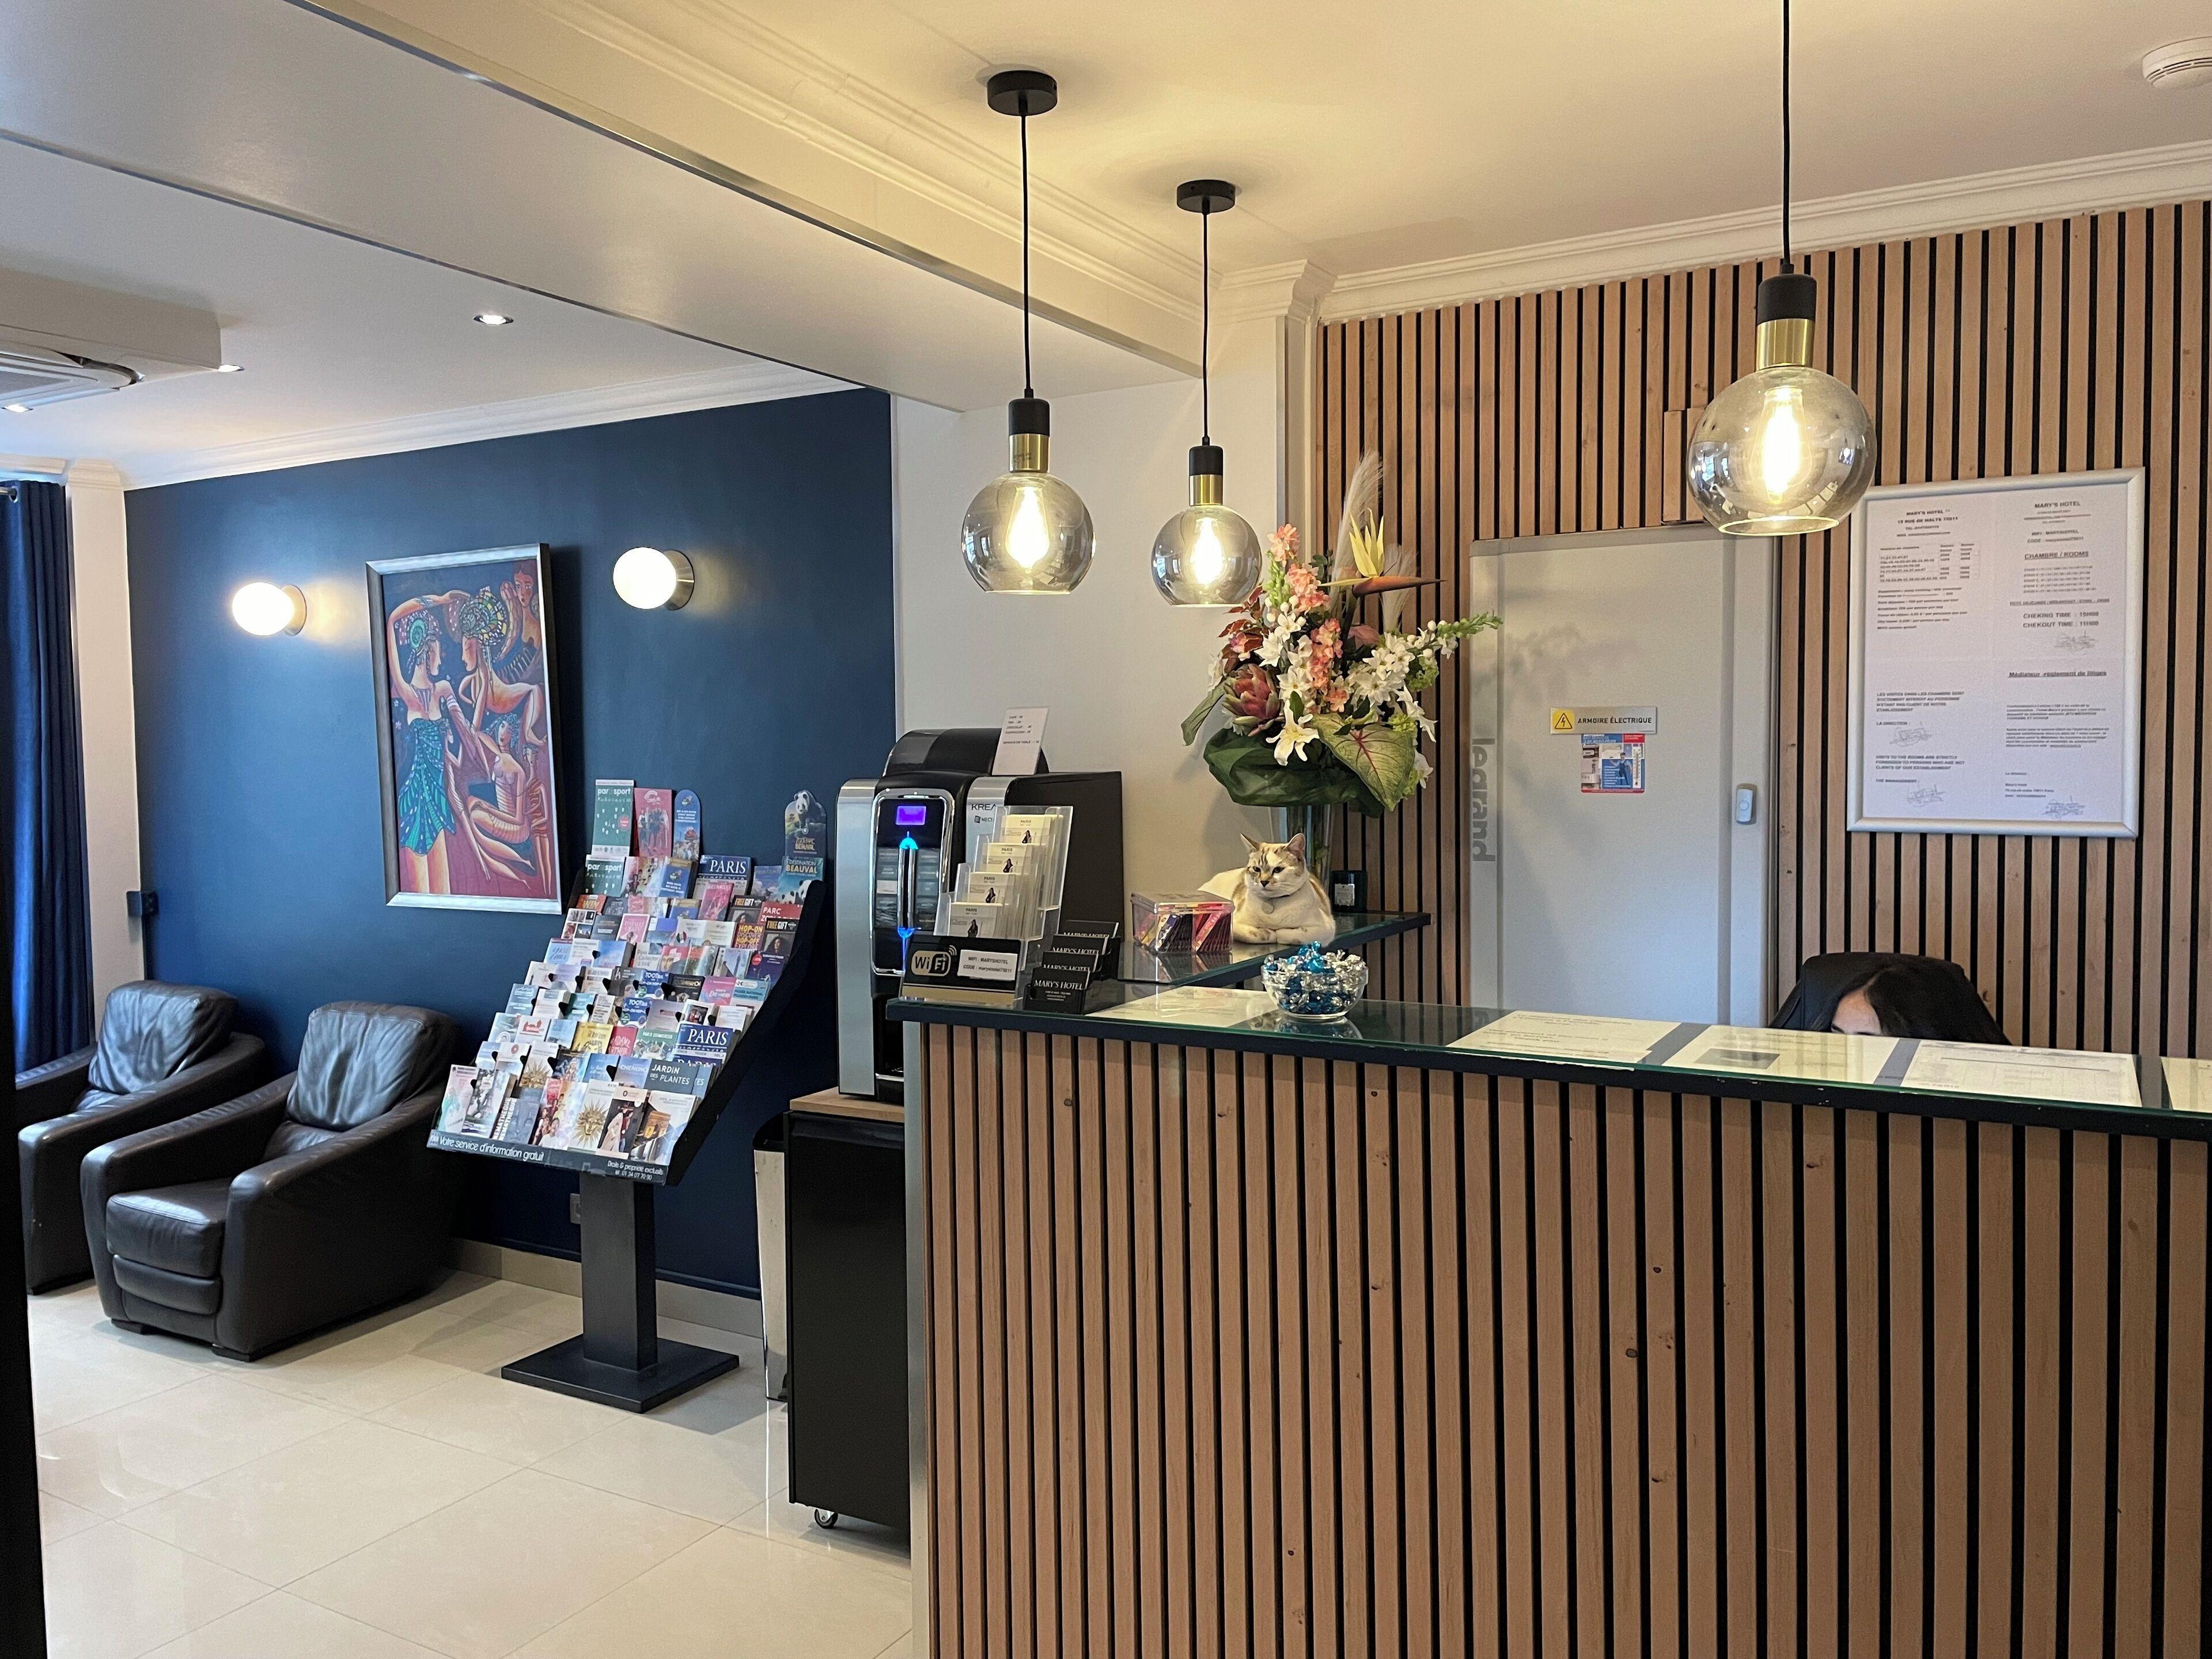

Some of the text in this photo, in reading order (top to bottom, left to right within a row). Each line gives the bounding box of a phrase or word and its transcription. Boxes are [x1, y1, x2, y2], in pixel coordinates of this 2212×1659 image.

[1610, 716, 1652, 724] ÉLECTRIQUE
[613, 787, 631, 797] sport
[1472, 737, 1496, 862] legrand
[587, 864, 622, 873] par sport
[710, 859, 747, 874] PARIS
[786, 863, 817, 873] BEAUVAL
[763, 907, 781, 915] PARC
[767, 921, 788, 930] FREE GIFT
[1034, 979, 1083, 990] MARY'S HOTEL
[687, 1028, 729, 1046] PARIS
[652, 1064, 681, 1074] JARDIN
[660, 1075, 690, 1085] PLANTES
[439, 1135, 544, 1162] Votre service d'information gratuit
